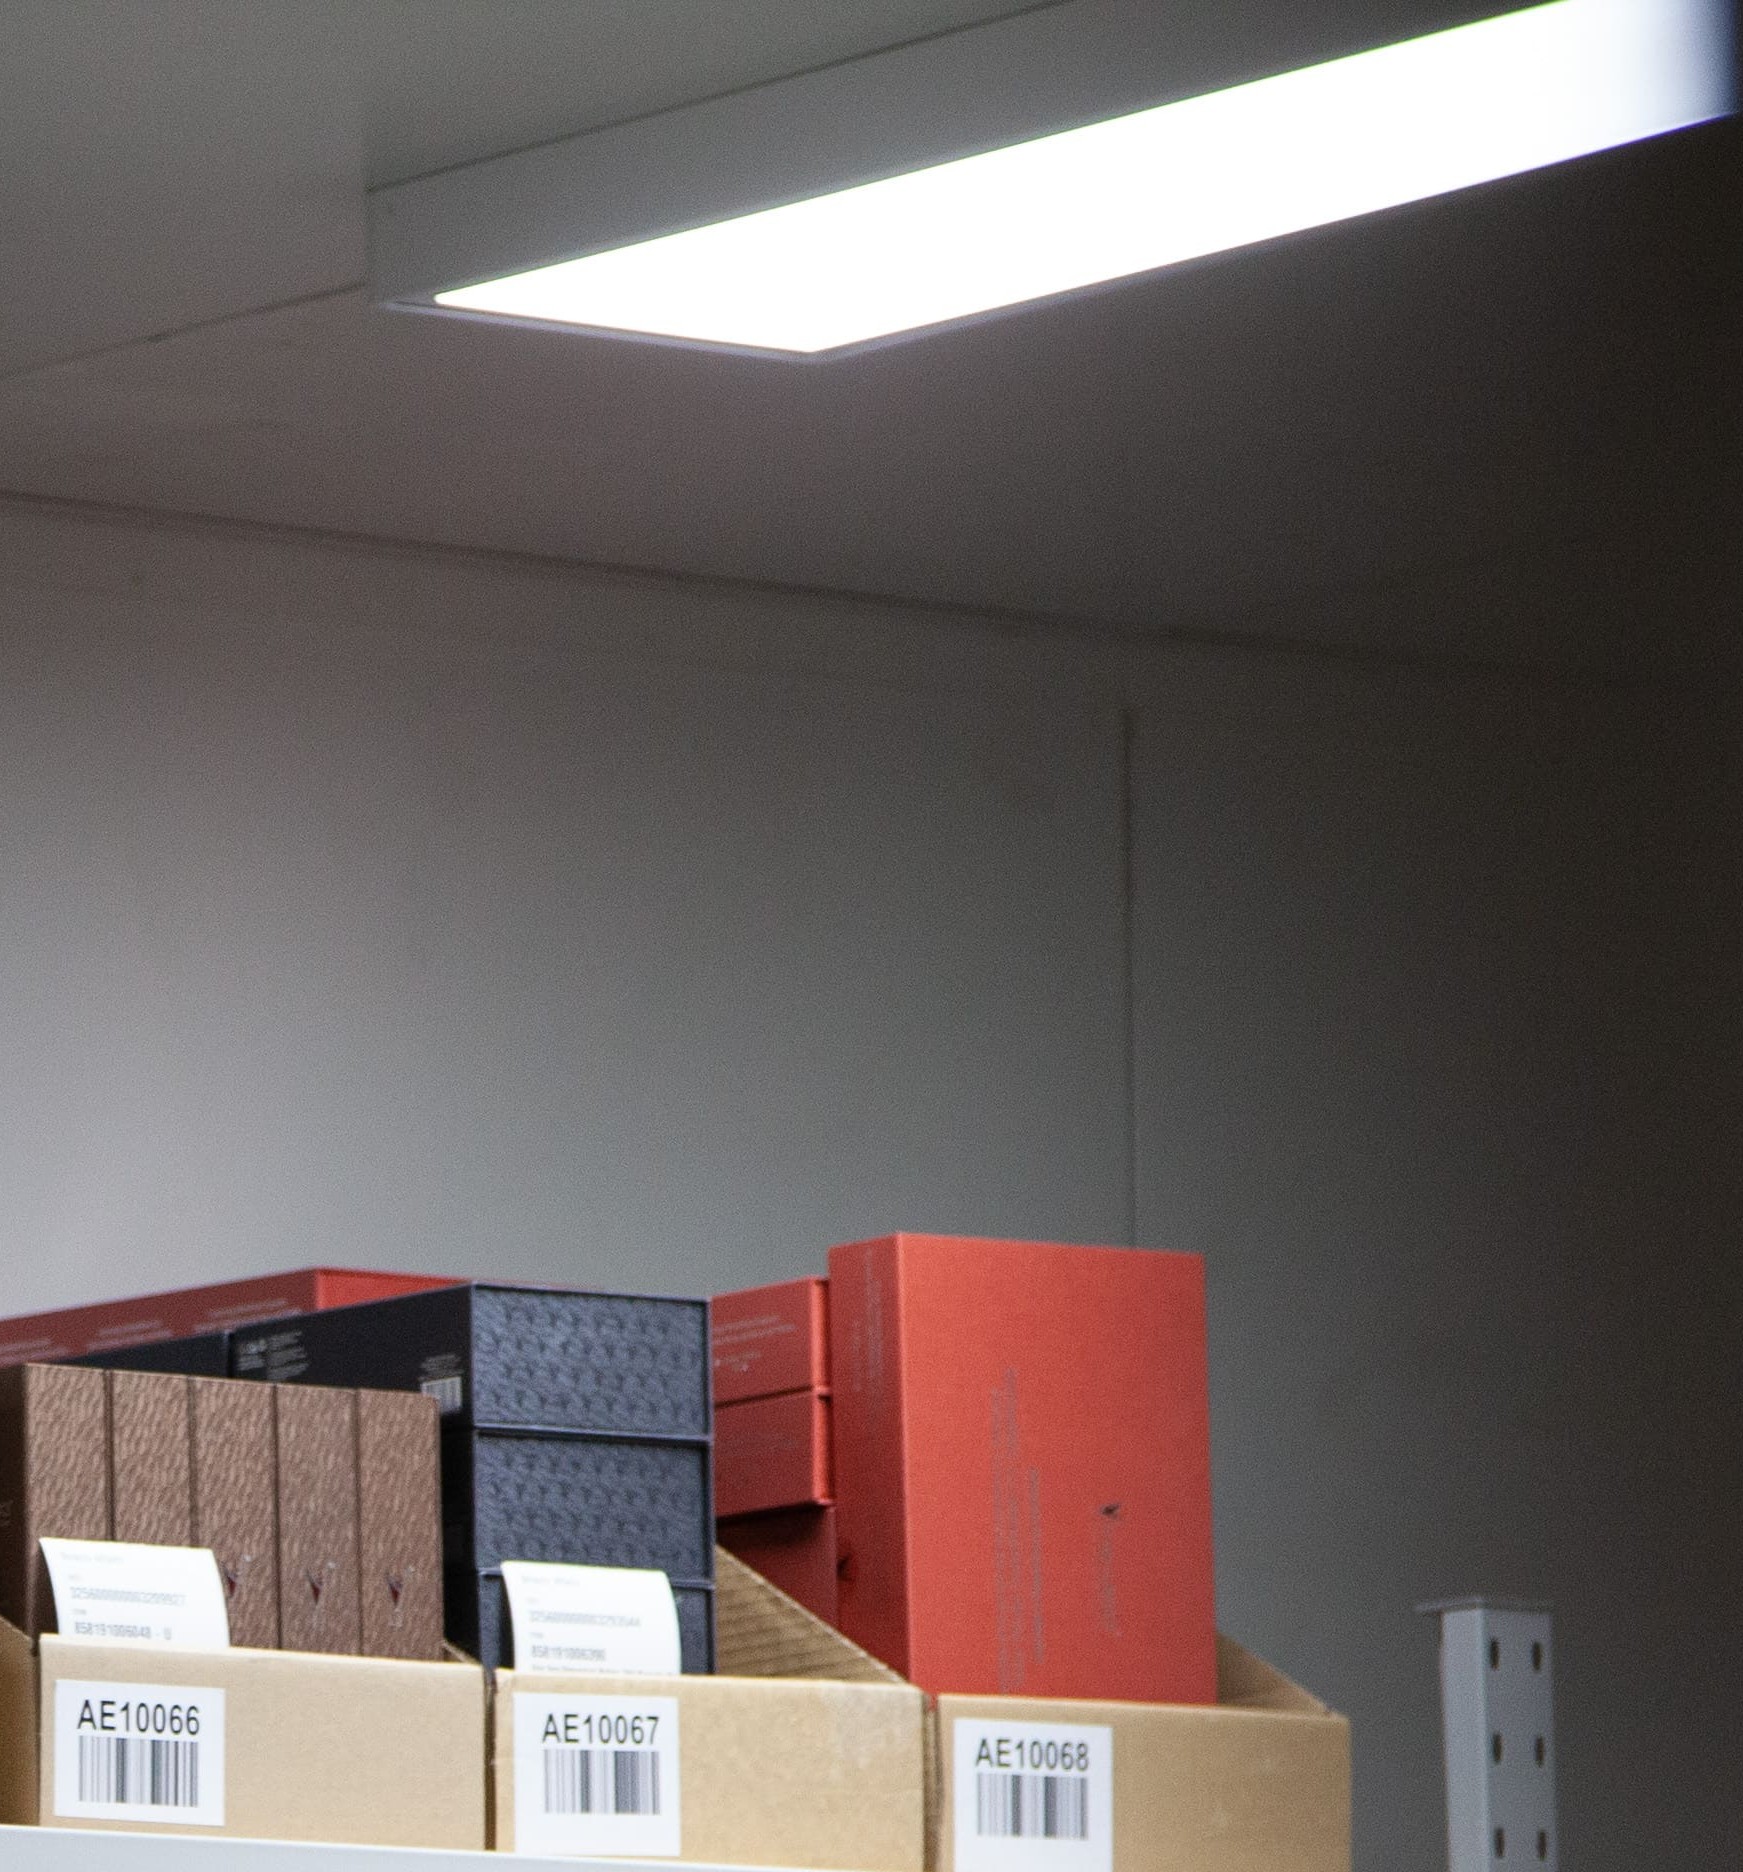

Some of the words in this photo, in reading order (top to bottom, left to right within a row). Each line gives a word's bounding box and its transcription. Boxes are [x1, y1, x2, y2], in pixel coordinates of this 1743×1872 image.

[77, 1699, 200, 1736] AE10066
[542, 1713, 660, 1745] AE10067
[975, 1738, 1089, 1772] AE10068
